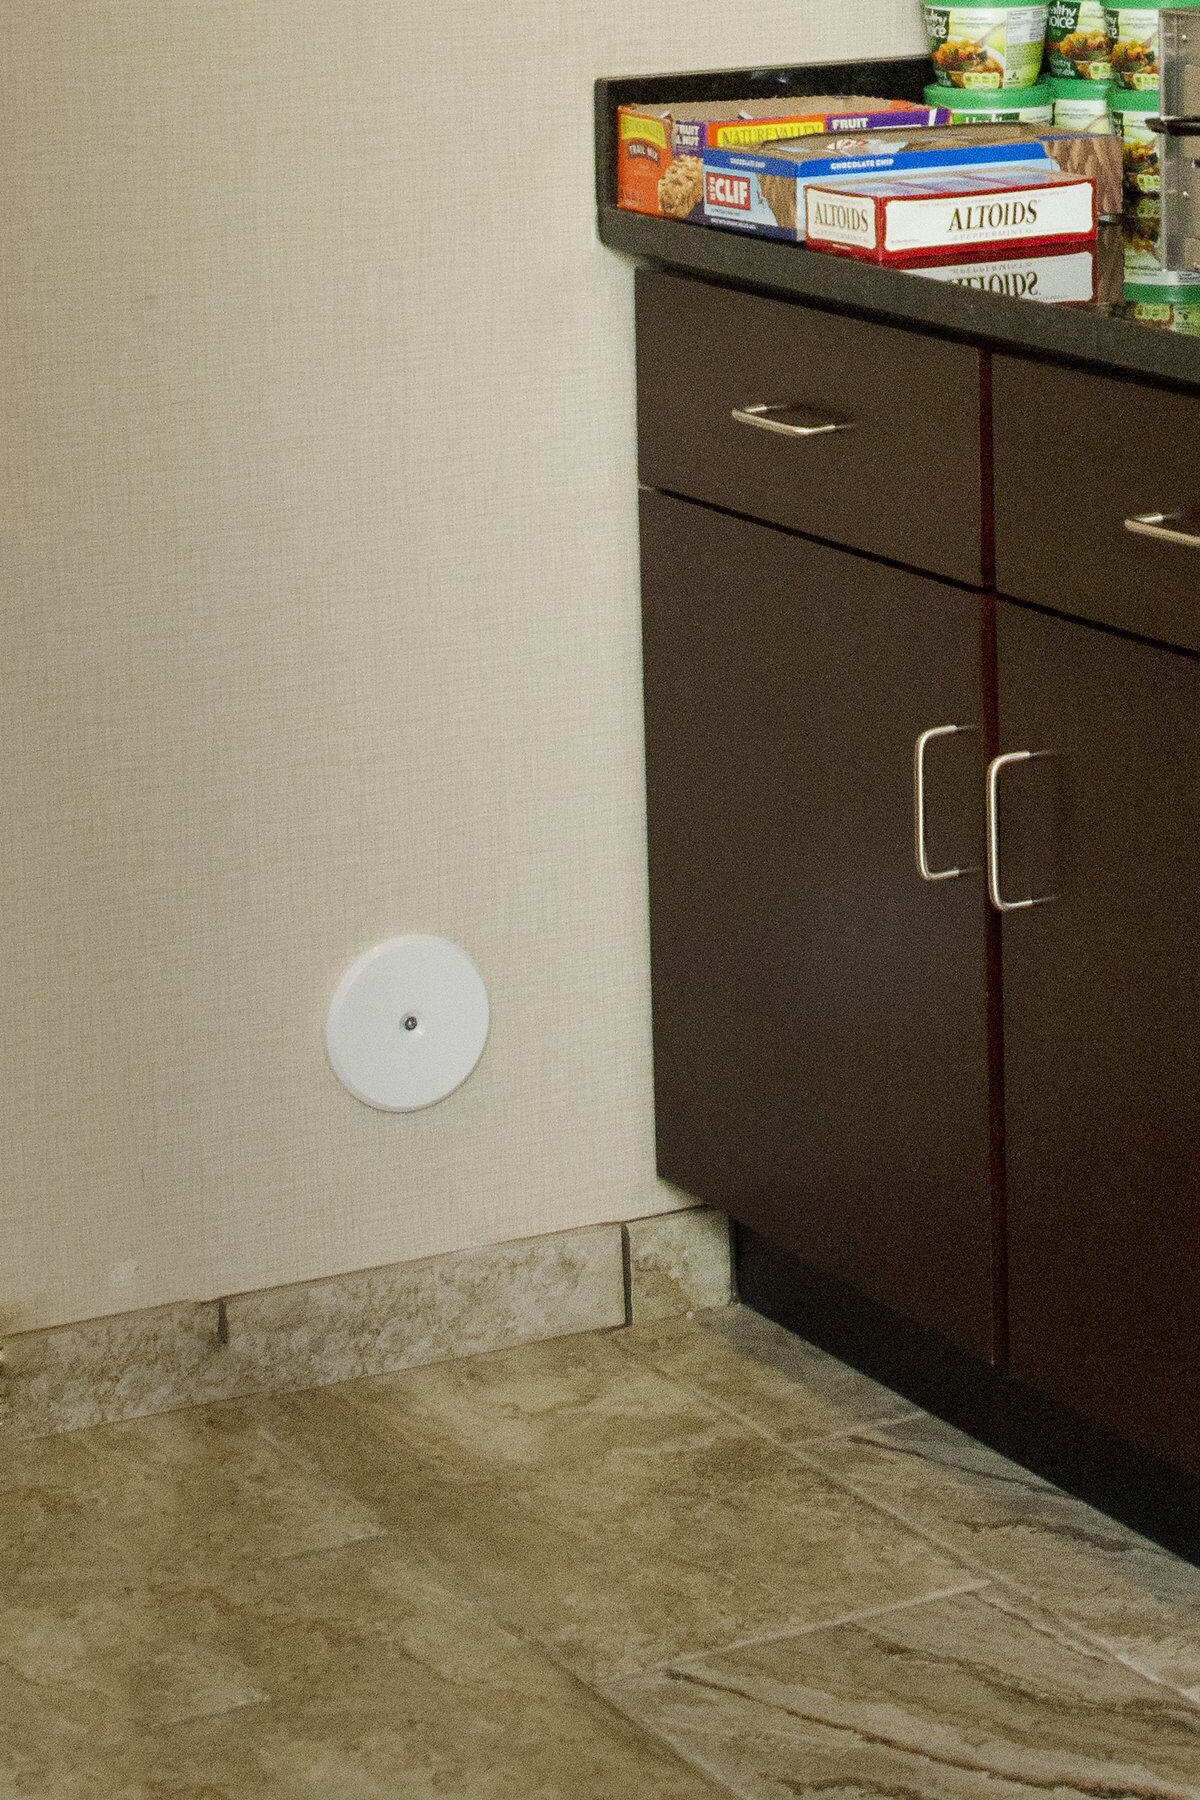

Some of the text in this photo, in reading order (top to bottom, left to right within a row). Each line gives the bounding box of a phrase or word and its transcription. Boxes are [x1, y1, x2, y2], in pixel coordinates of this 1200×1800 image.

[831, 117, 869, 131] FRUIT
[830, 157, 895, 171] CHOCOLATE CHIP
[715, 177, 748, 206] CLIF
[814, 202, 870, 233] ALTOIDS
[946, 200, 1038, 234] ALTOIDS
